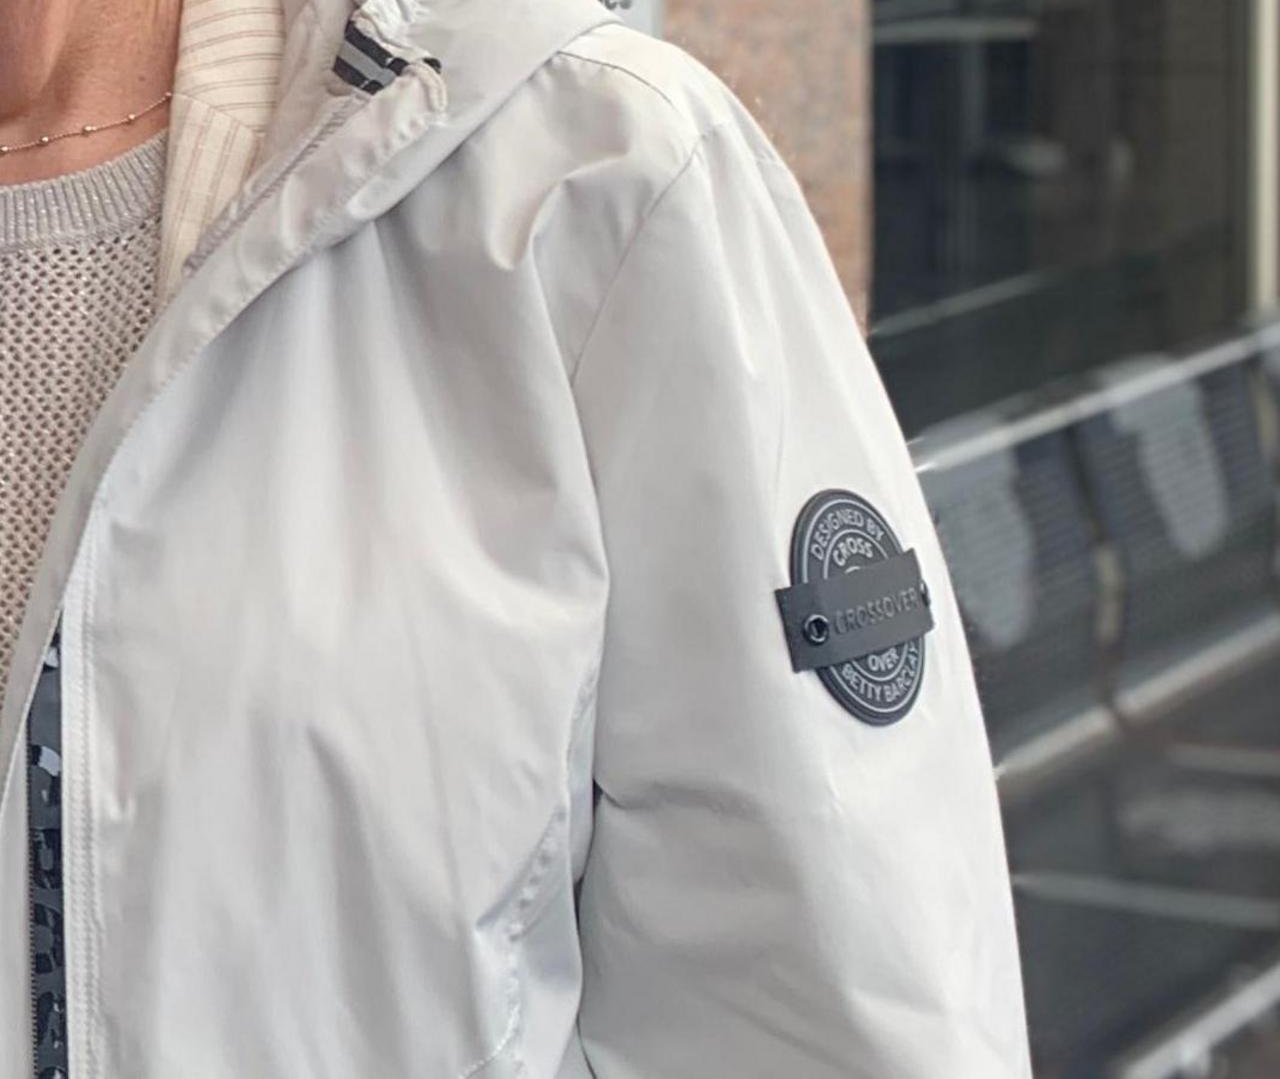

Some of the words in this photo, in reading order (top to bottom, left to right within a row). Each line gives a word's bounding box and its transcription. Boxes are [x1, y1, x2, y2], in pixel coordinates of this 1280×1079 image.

[811, 508, 864, 560] DESIGNED
[832, 536, 874, 567] CROSS
[834, 587, 919, 634] CROSSOVER
[867, 646, 899, 672] OVER
[841, 662, 881, 702] BETTY
